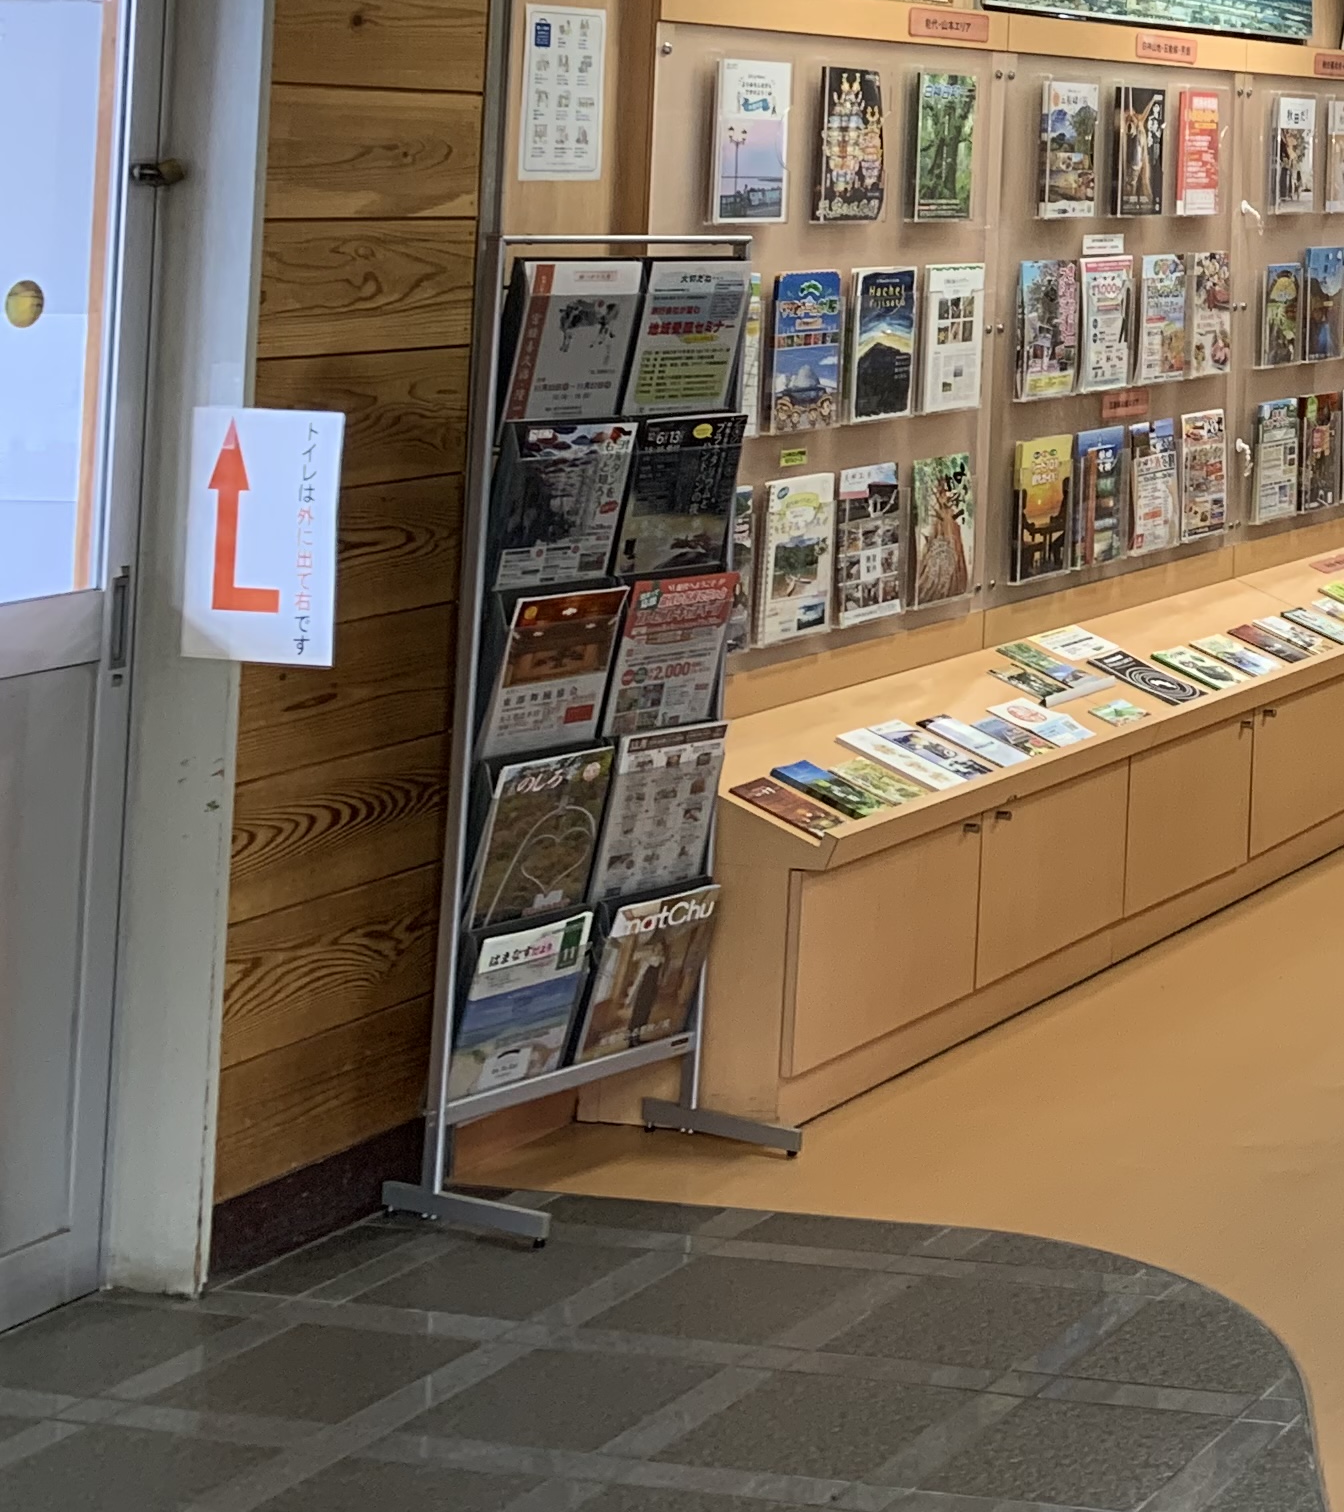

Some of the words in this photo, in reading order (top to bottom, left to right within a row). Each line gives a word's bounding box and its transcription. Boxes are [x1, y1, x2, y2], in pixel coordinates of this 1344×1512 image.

[292, 422, 319, 656] トイレは外に出て右です
